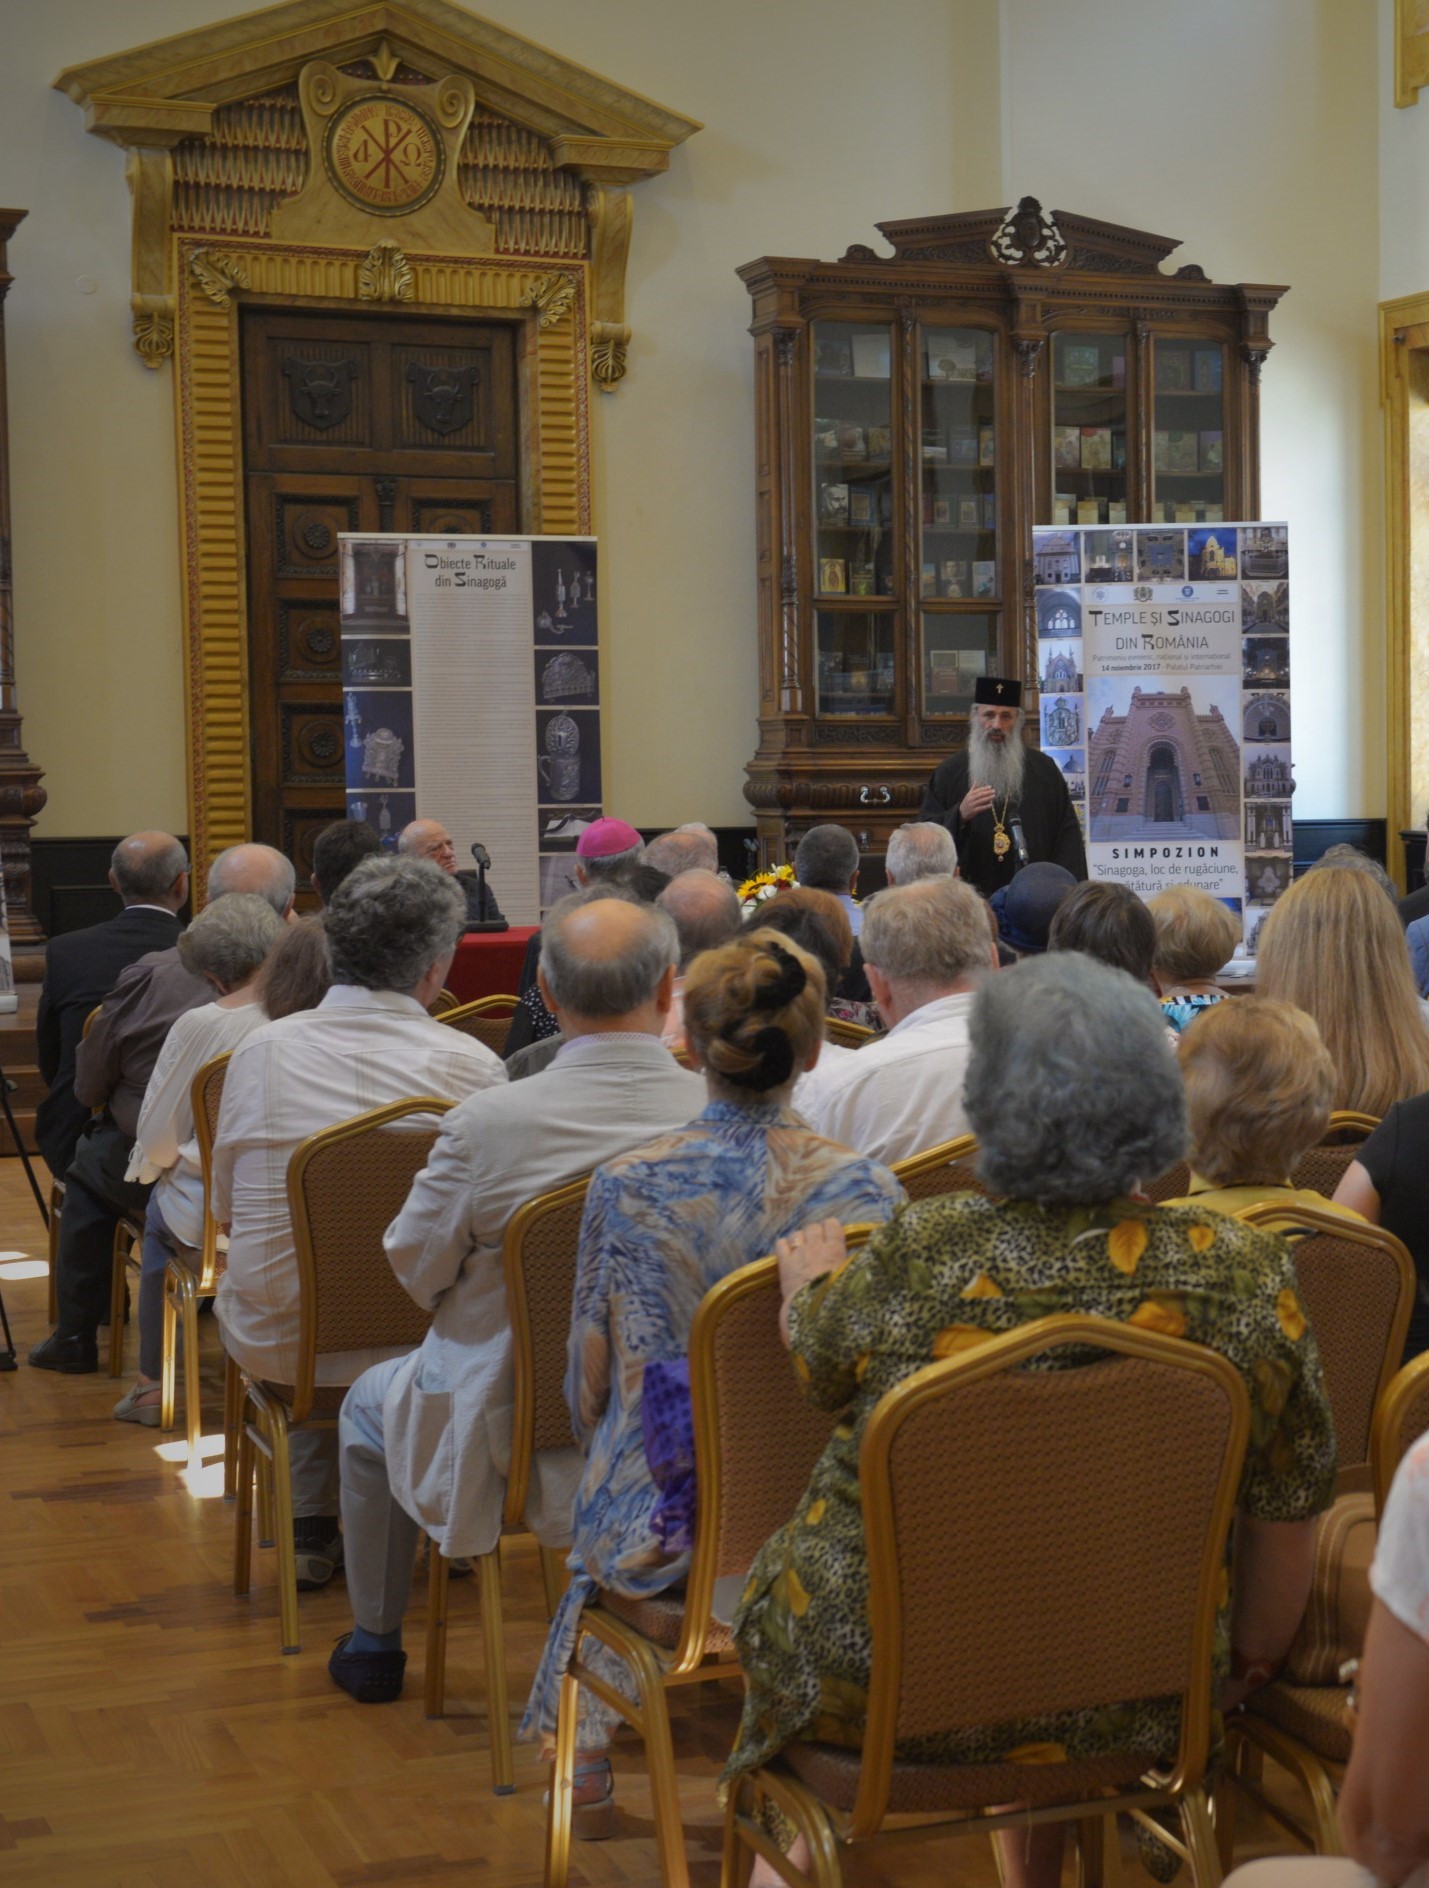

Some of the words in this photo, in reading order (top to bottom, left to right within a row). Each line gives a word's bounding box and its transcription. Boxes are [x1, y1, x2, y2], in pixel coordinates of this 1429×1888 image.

[424, 553, 471, 570] Obiecte
[473, 554, 516, 570] Rituale
[435, 574, 451, 587] din
[454, 571, 507, 590] Sinagogă
[1088, 610, 1147, 626] TEMPLE
[1150, 611, 1162, 627] ȘI
[1167, 609, 1235, 626] SINAGOGI
[1115, 637, 1138, 650] DIN
[1141, 634, 1209, 650] ROMÂNIA
[1143, 663, 1161, 671] 2017
[1112, 846, 1219, 859] SIMPOZION
[1150, 863, 1165, 875] loc
[1168, 863, 1181, 875] de
[1184, 863, 1239, 877] rugăciune,
